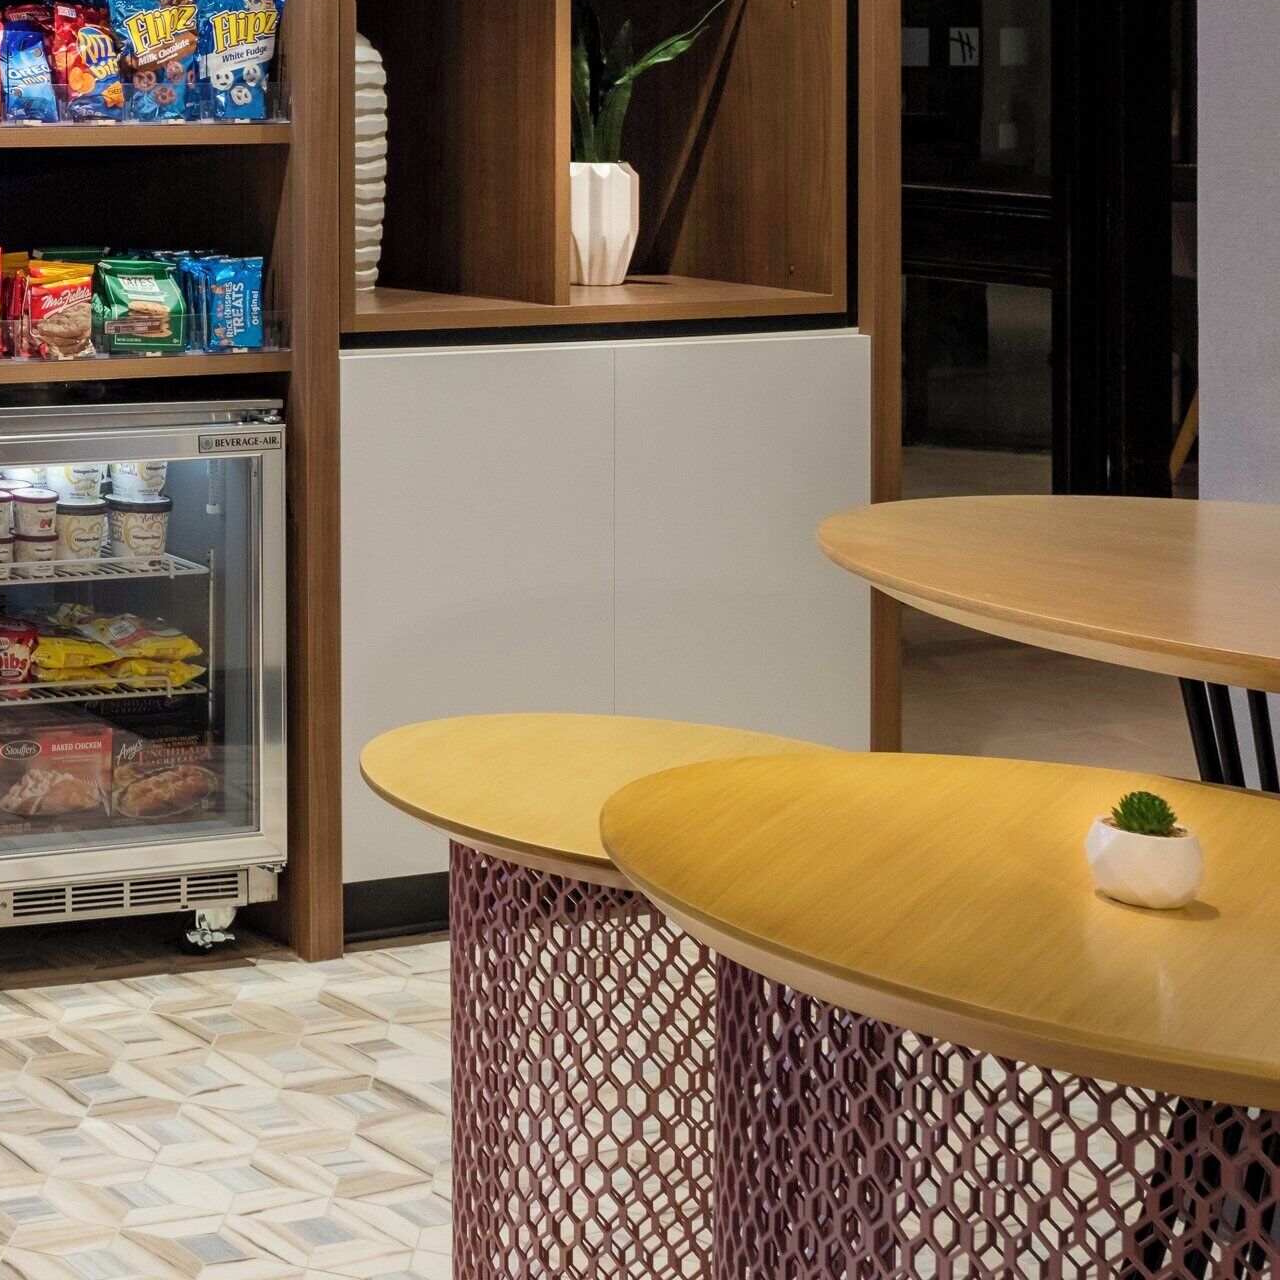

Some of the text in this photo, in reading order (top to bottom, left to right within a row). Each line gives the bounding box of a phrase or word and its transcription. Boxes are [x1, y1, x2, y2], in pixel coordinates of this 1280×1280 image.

[124, 5, 199, 55] Flipz
[210, 10, 278, 54] Flipz
[138, 38, 190, 67] Milk Chocolate
[222, 44, 268, 63] White Fudge
[8, 65, 51, 80] OREO
[119, 275, 155, 286] TATE'S
[60, 286, 92, 307] Fields
[232, 282, 244, 335] TREATS
[215, 436, 278, 448] BEVERAGE-AIR
[3, 744, 38, 757] Stouffer's
[51, 741, 102, 752] BAKED CHICKEN
[116, 739, 144, 765] Amy's
